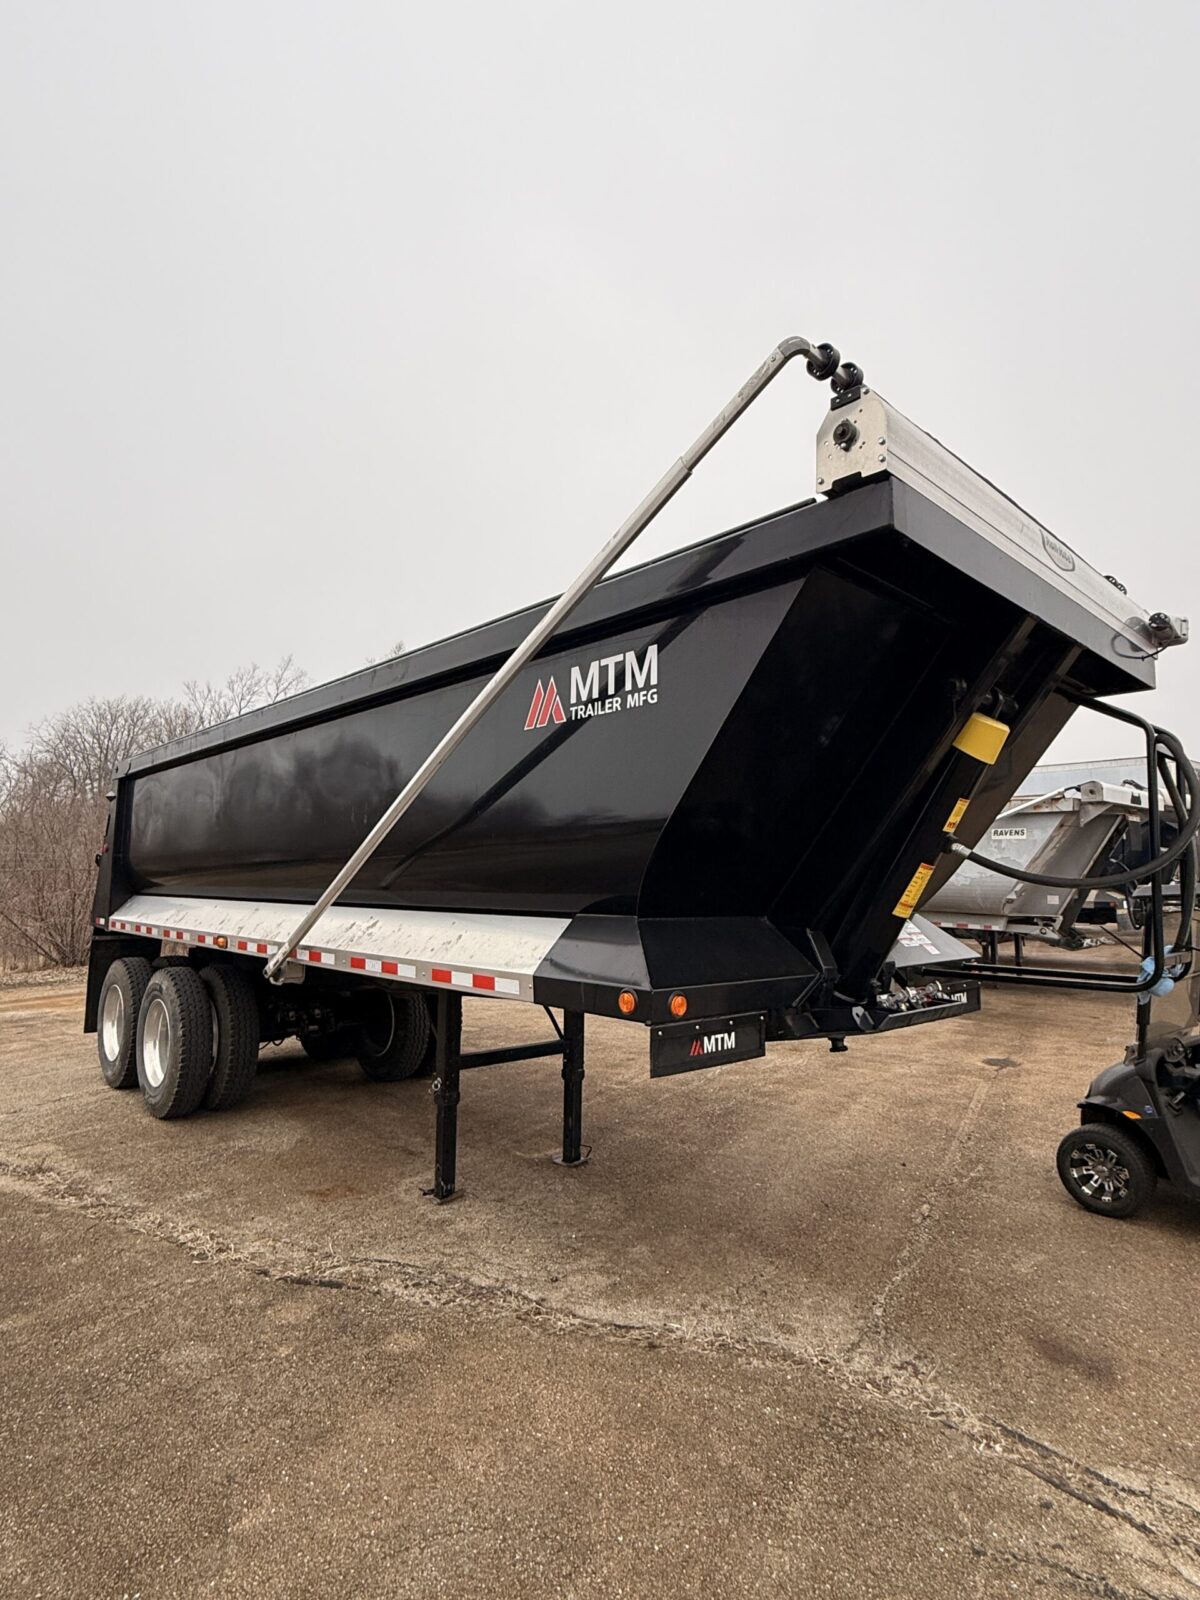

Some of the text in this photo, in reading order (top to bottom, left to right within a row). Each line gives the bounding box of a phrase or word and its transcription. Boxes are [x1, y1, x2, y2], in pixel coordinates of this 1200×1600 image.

[570, 644, 658, 704] MTM
[570, 688, 658, 721] TRAILER MFG
[993, 829, 1025, 837] RAVENS
[703, 1031, 736, 1054] MTM
